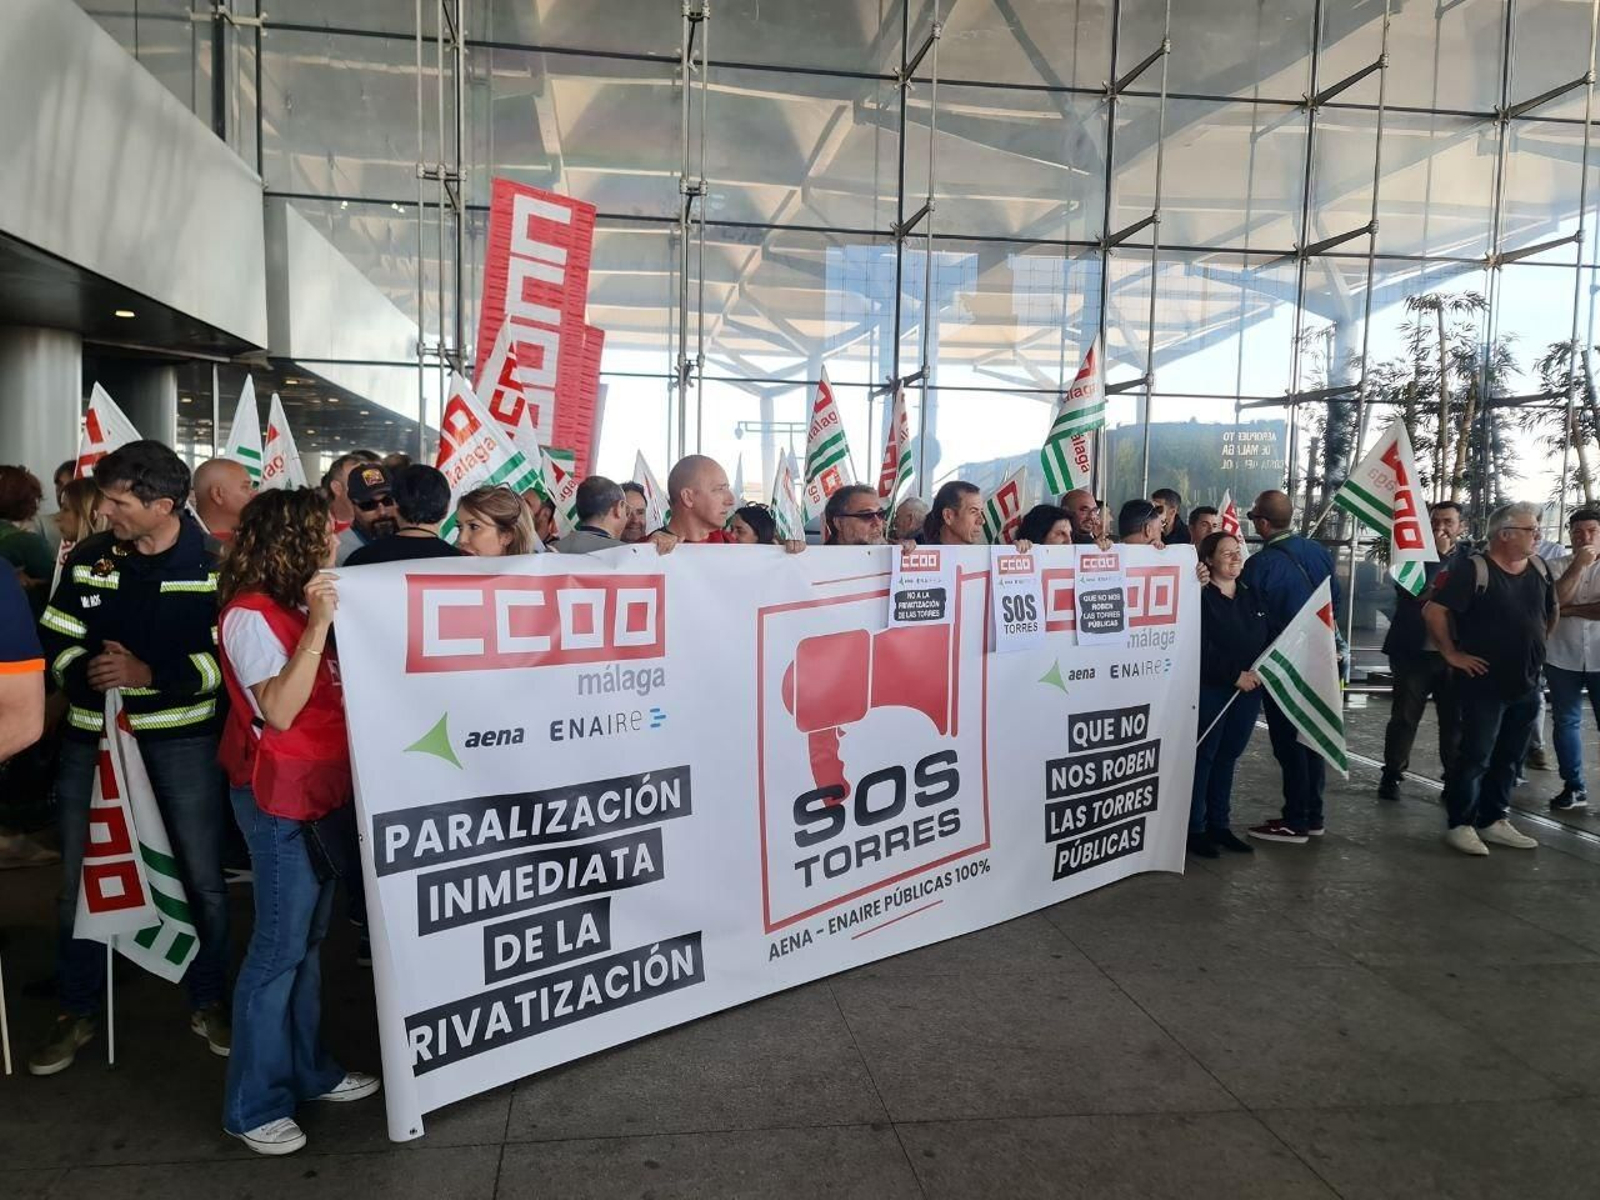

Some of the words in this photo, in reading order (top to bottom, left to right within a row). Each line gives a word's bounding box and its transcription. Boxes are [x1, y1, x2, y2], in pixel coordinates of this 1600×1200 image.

[902, 555, 937, 568] CCOO
[1000, 559, 1031, 571] CCOO
[1083, 557, 1116, 569] CCOO
[422, 588, 657, 657] CCOO
[905, 610, 917, 618] LAS
[1002, 594, 1037, 623] SOS
[1004, 622, 1038, 634] TORRES
[1096, 611, 1121, 619] TORRES
[578, 664, 666, 696] málaga
[1068, 667, 1096, 681] aena
[464, 726, 525, 748] aena
[1072, 717, 1115, 748] QUE
[1120, 712, 1146, 739] NO
[1051, 762, 1096, 792] NOS
[1102, 747, 1156, 783] ROBEN
[793, 749, 960, 848] SOS
[1050, 805, 1087, 835] LAS
[1092, 785, 1153, 824] TORRES
[384, 774, 682, 864] PARALIZACIÓN
[794, 808, 961, 888] TORRES
[1057, 824, 1141, 874] PÚBLICAS
[429, 842, 655, 922] INMEDIATA
[768, 929, 813, 962] AENA
[828, 900, 881, 935] ENAIRE
[884, 872, 952, 912] PÚBLICAS
[954, 859, 990, 883] 100%
[494, 925, 543, 972] DE
[556, 912, 601, 954] LA
[408, 942, 696, 1066] RIVATIZACIÓN
